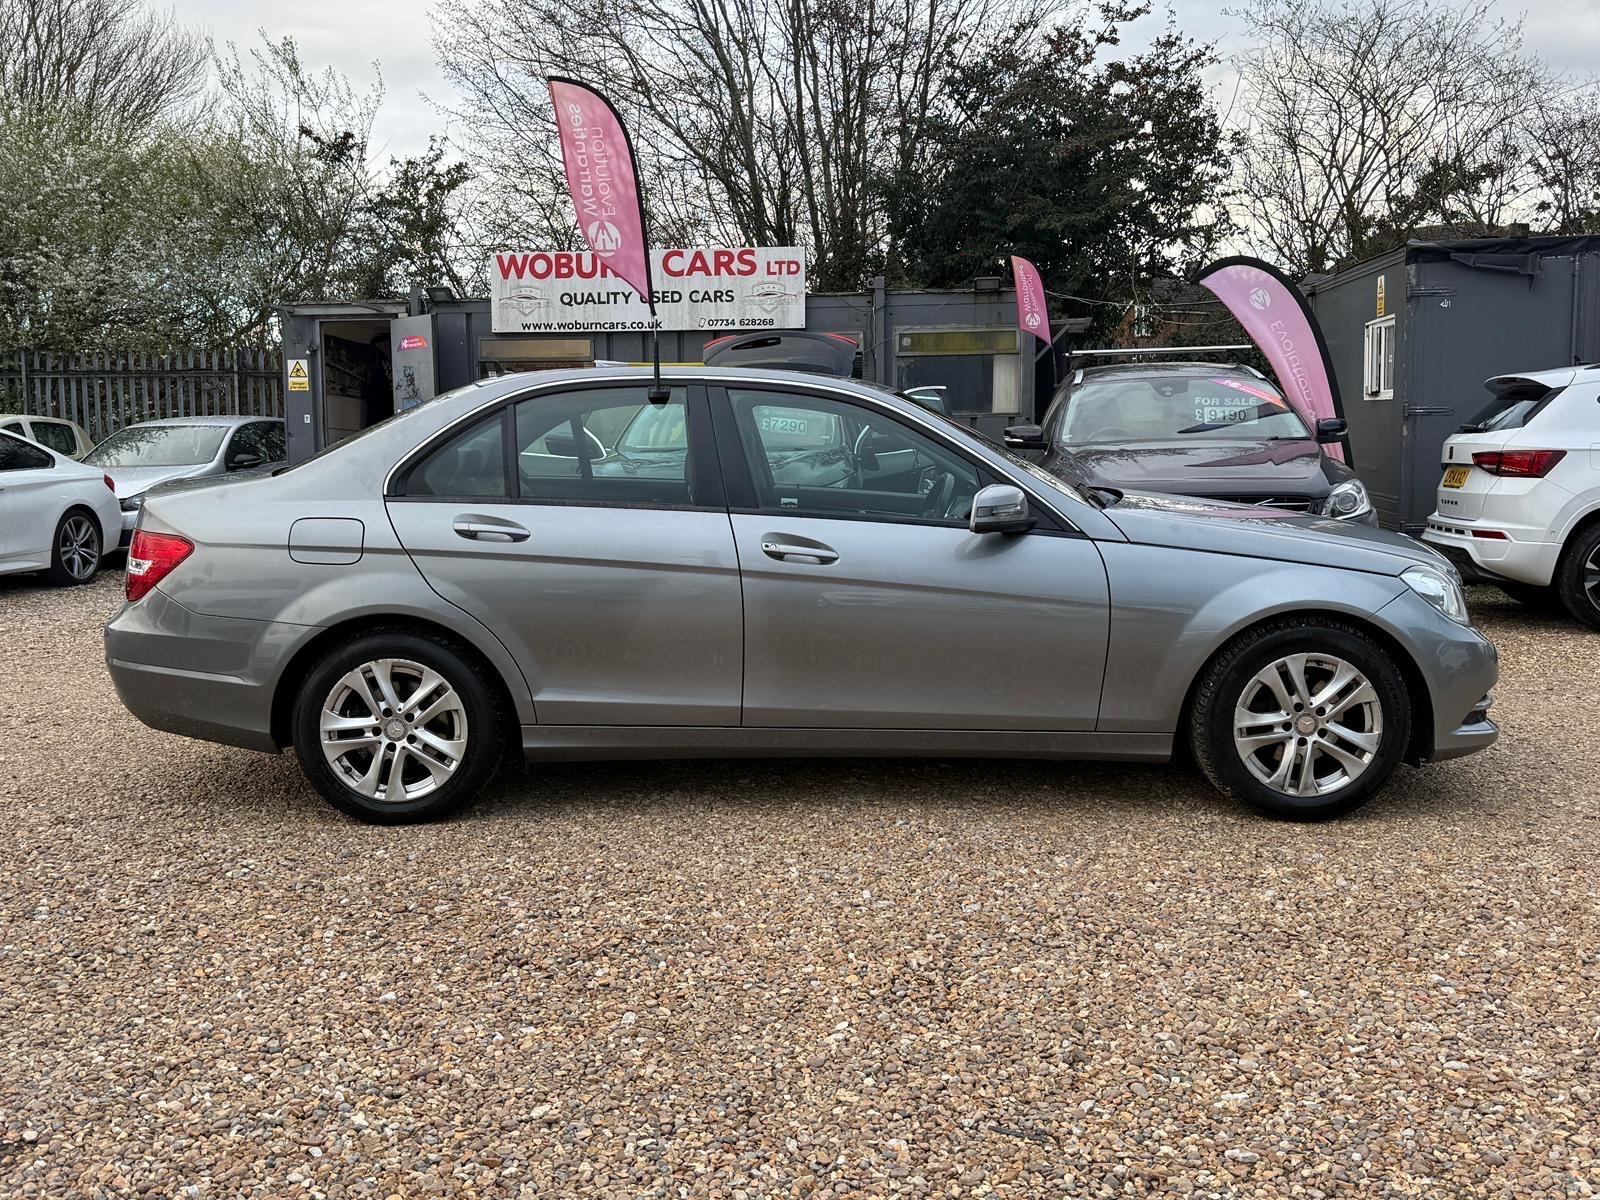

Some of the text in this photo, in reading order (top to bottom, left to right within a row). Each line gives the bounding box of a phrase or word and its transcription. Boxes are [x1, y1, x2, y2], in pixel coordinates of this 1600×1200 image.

[496, 250, 800, 279] WOBU CARS LTD
[560, 291, 632, 306] QUALITY
[689, 289, 734, 303] CARS
[521, 319, 662, 331] www.woburncars.co.uk
[708, 318, 774, 327] 07734 628268
[1194, 397, 1257, 406] FOR SALE
